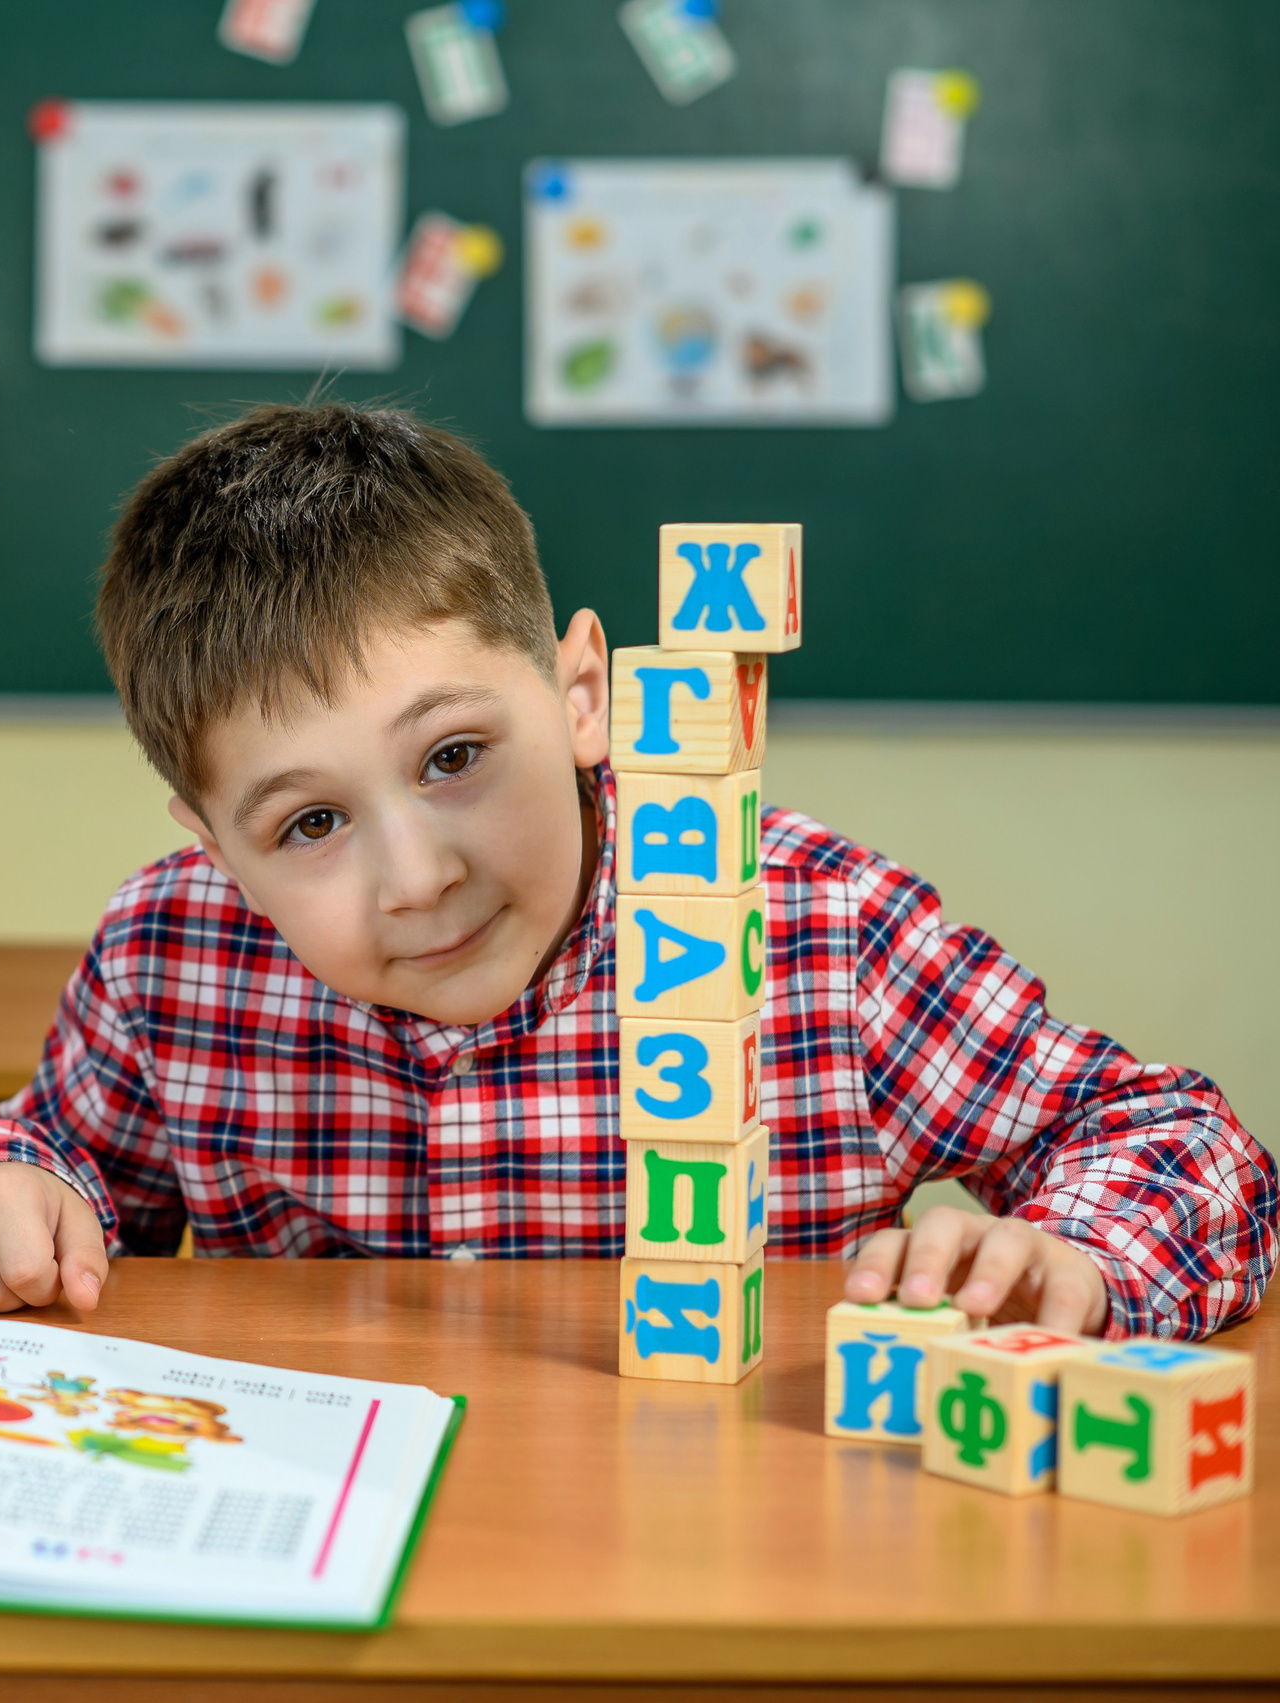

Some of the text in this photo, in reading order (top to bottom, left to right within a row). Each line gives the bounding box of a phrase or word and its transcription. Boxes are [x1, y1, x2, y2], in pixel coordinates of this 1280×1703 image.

[672, 543, 765, 632] Ж
[785, 547, 799, 635] А
[634, 667, 711, 755] Г
[736, 662, 763, 750] А
[632, 796, 718, 884] В
[634, 909, 726, 1002] А
[741, 908, 763, 997] С
[626, 1275, 721, 1364] Й
[834, 1331, 925, 1435] Й
[937, 1371, 1007, 1468] Ф
[1073, 1393, 1154, 1483] Т
[1188, 1387, 1247, 1493] И
